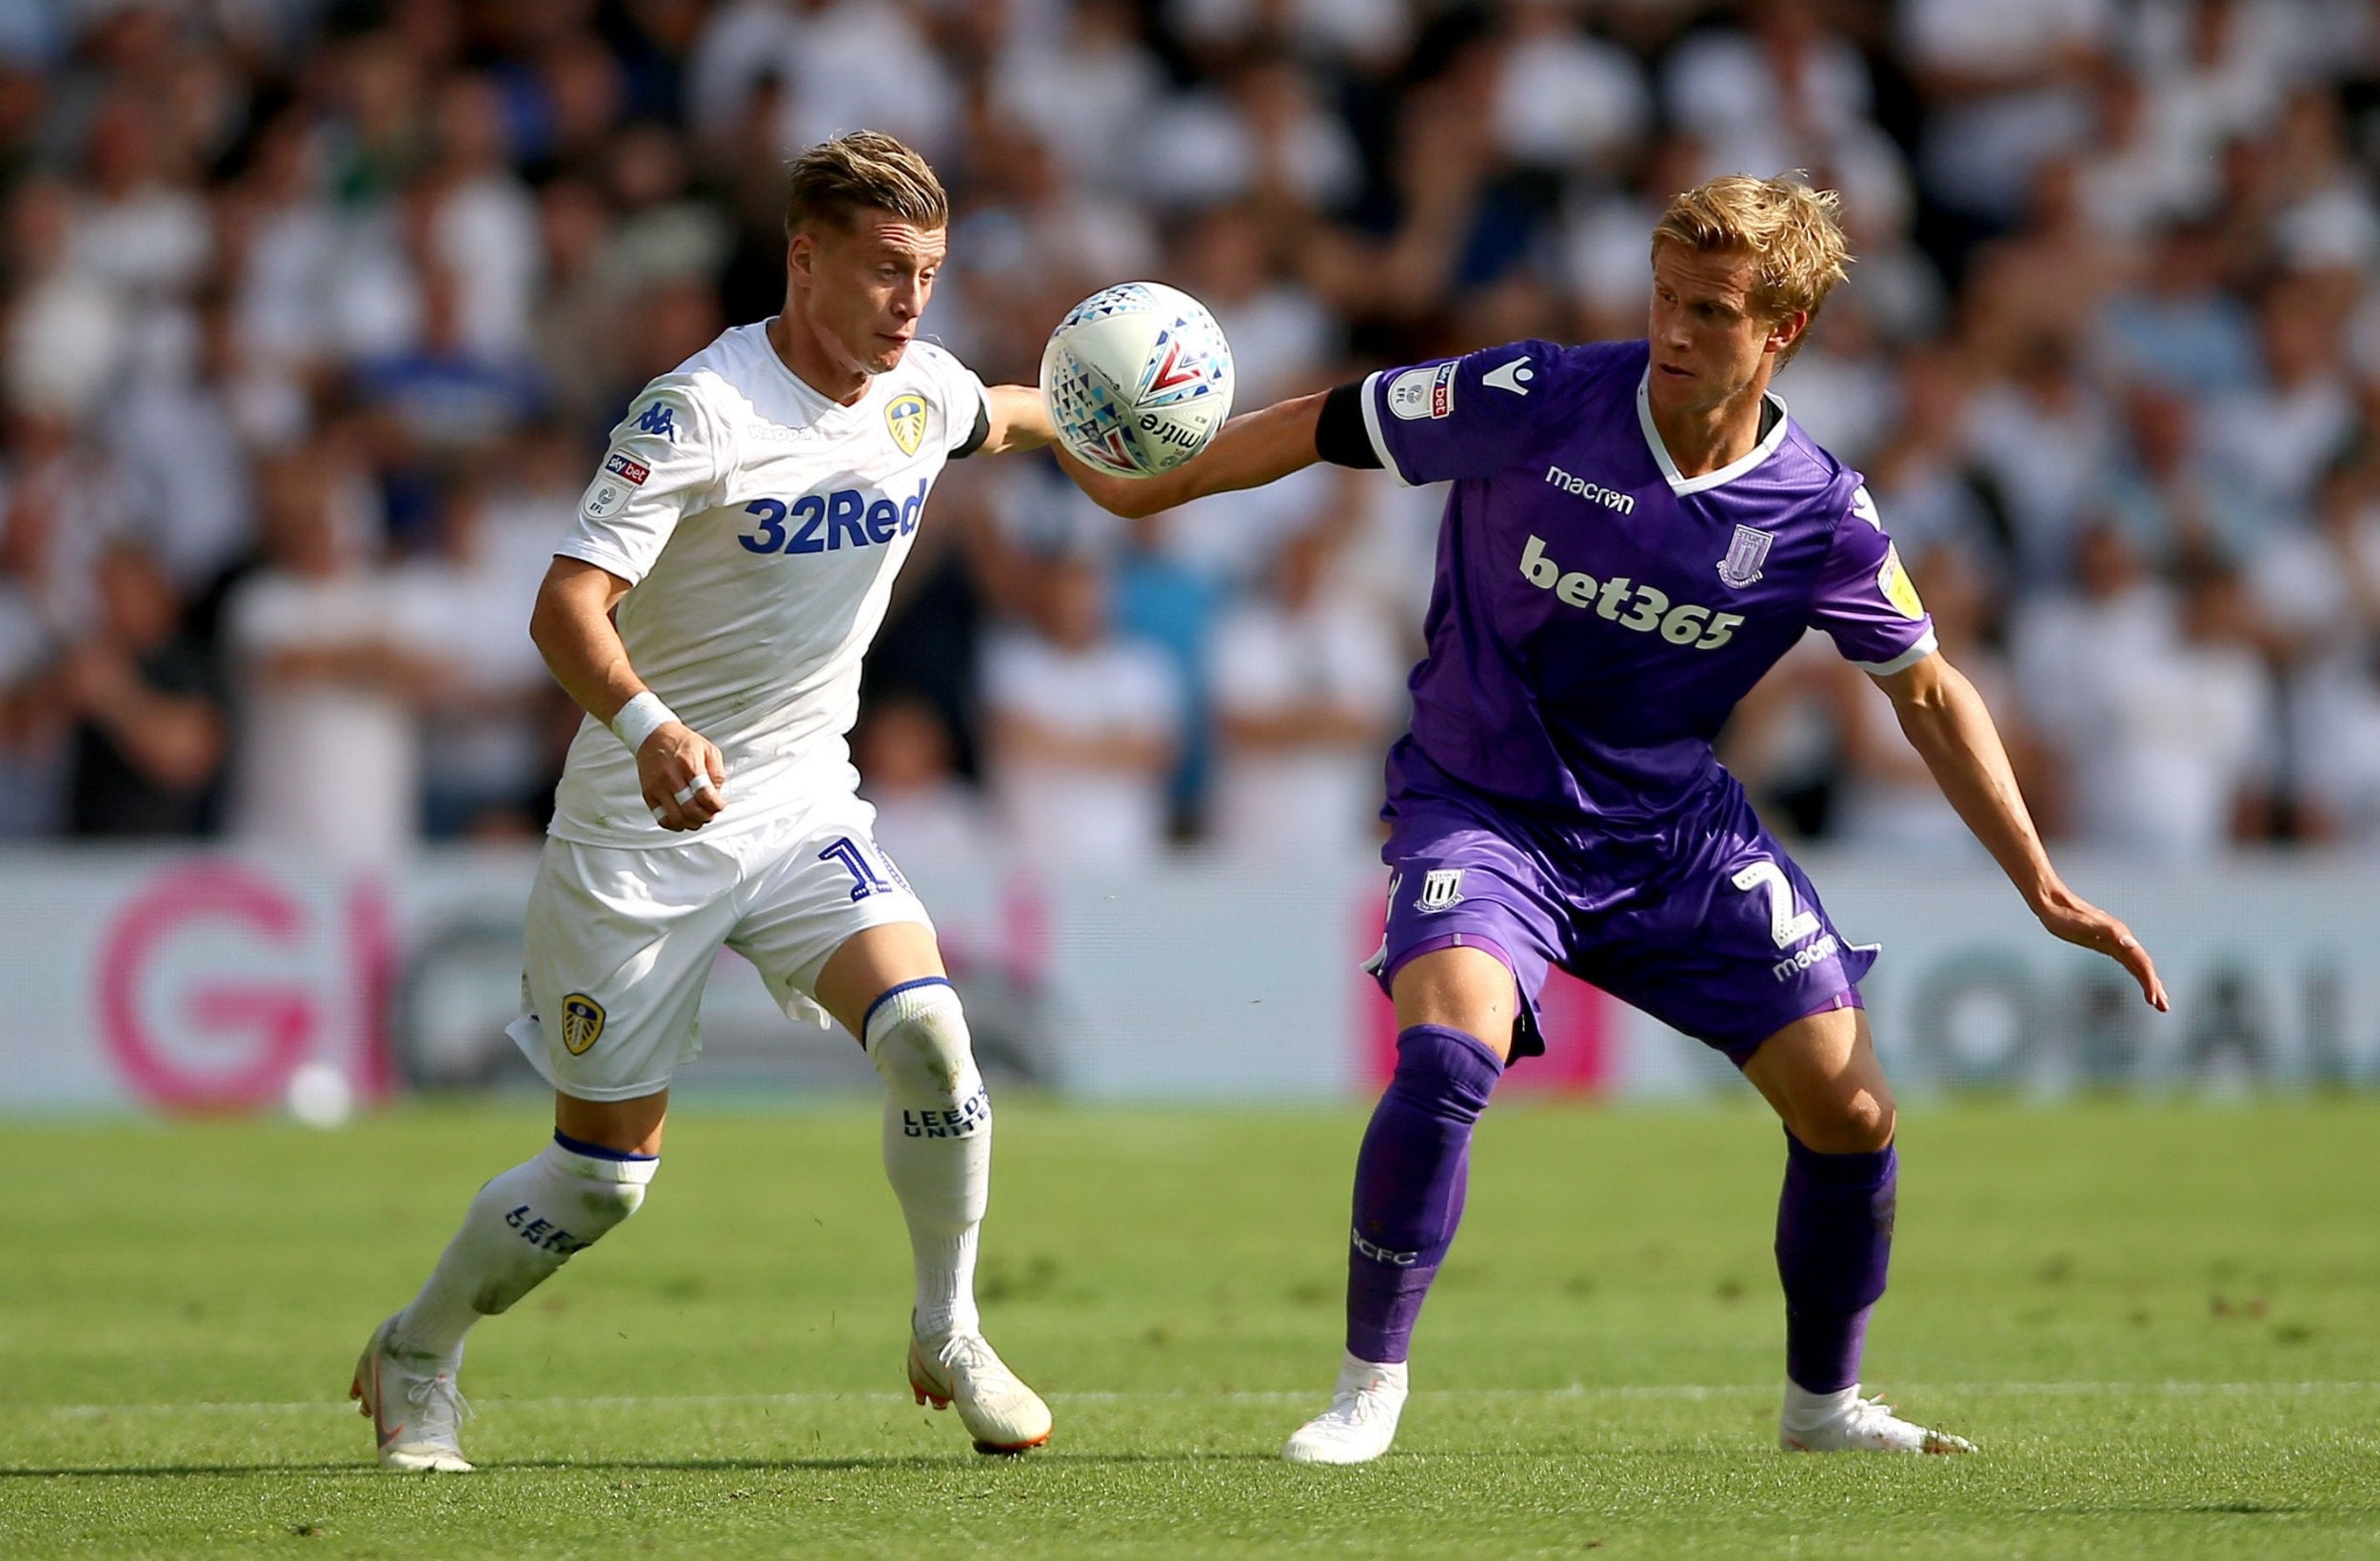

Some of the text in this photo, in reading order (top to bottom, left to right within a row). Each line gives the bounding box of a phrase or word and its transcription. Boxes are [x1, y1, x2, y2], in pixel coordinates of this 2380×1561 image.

[1397, 387, 1406, 405] EFL
[1435, 387, 1447, 414] bet
[1140, 413, 1201, 448] mitre
[609, 457, 625, 472] sky
[625, 464, 646, 482] bet
[1544, 465, 1636, 515] macron
[589, 503, 604, 514] EFL
[738, 478, 927, 554] 32Red
[1519, 534, 1745, 649] bet365
[819, 837, 911, 902] 1
[1731, 860, 1822, 949] 2
[903, 1107, 987, 1138] UNITE
